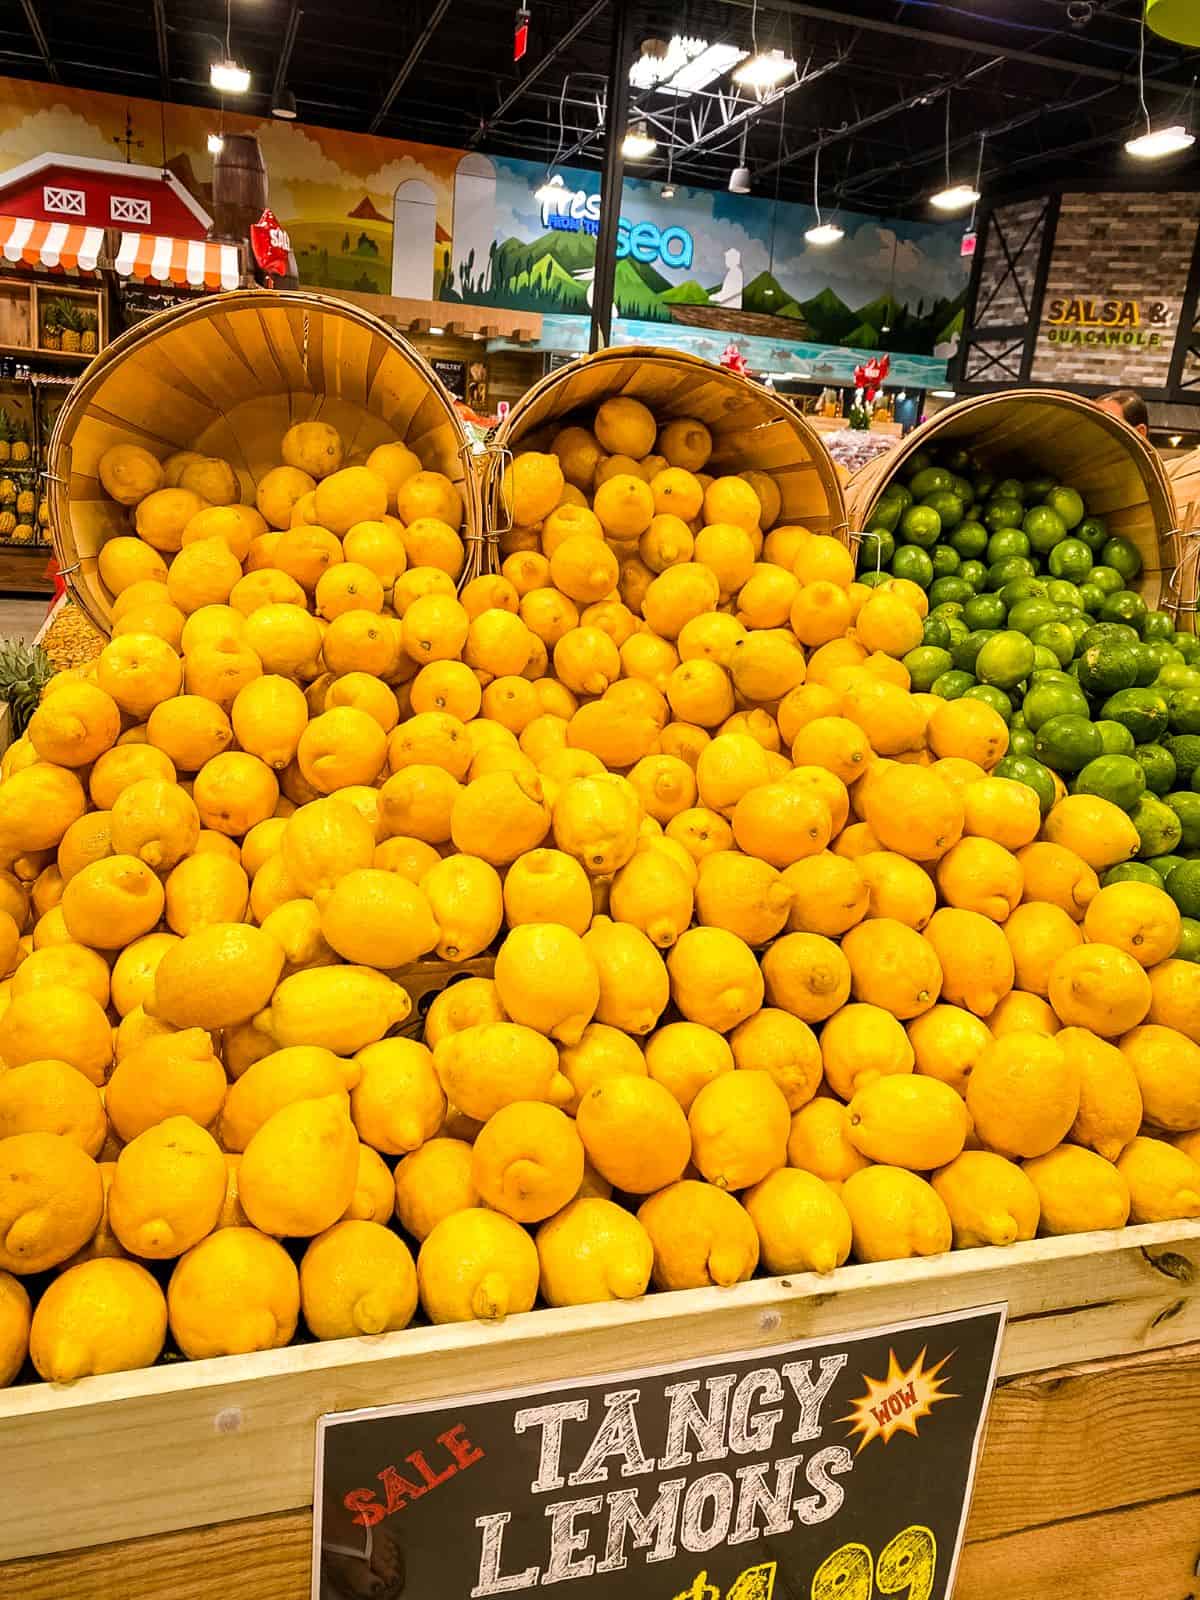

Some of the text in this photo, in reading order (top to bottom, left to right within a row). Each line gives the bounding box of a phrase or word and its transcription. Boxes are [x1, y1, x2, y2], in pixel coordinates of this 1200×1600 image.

[541, 175, 601, 227] fres
[581, 218, 600, 235] TH
[616, 216, 694, 269] sea
[1047, 329, 1161, 346] GUACAMOLE
[1048, 298, 1173, 327] SALSA &
[514, 1353, 848, 1493] TANGY
[869, 1381, 918, 1426] WOW
[343, 1423, 485, 1526] SALE
[470, 1445, 854, 1598] LEMONS
